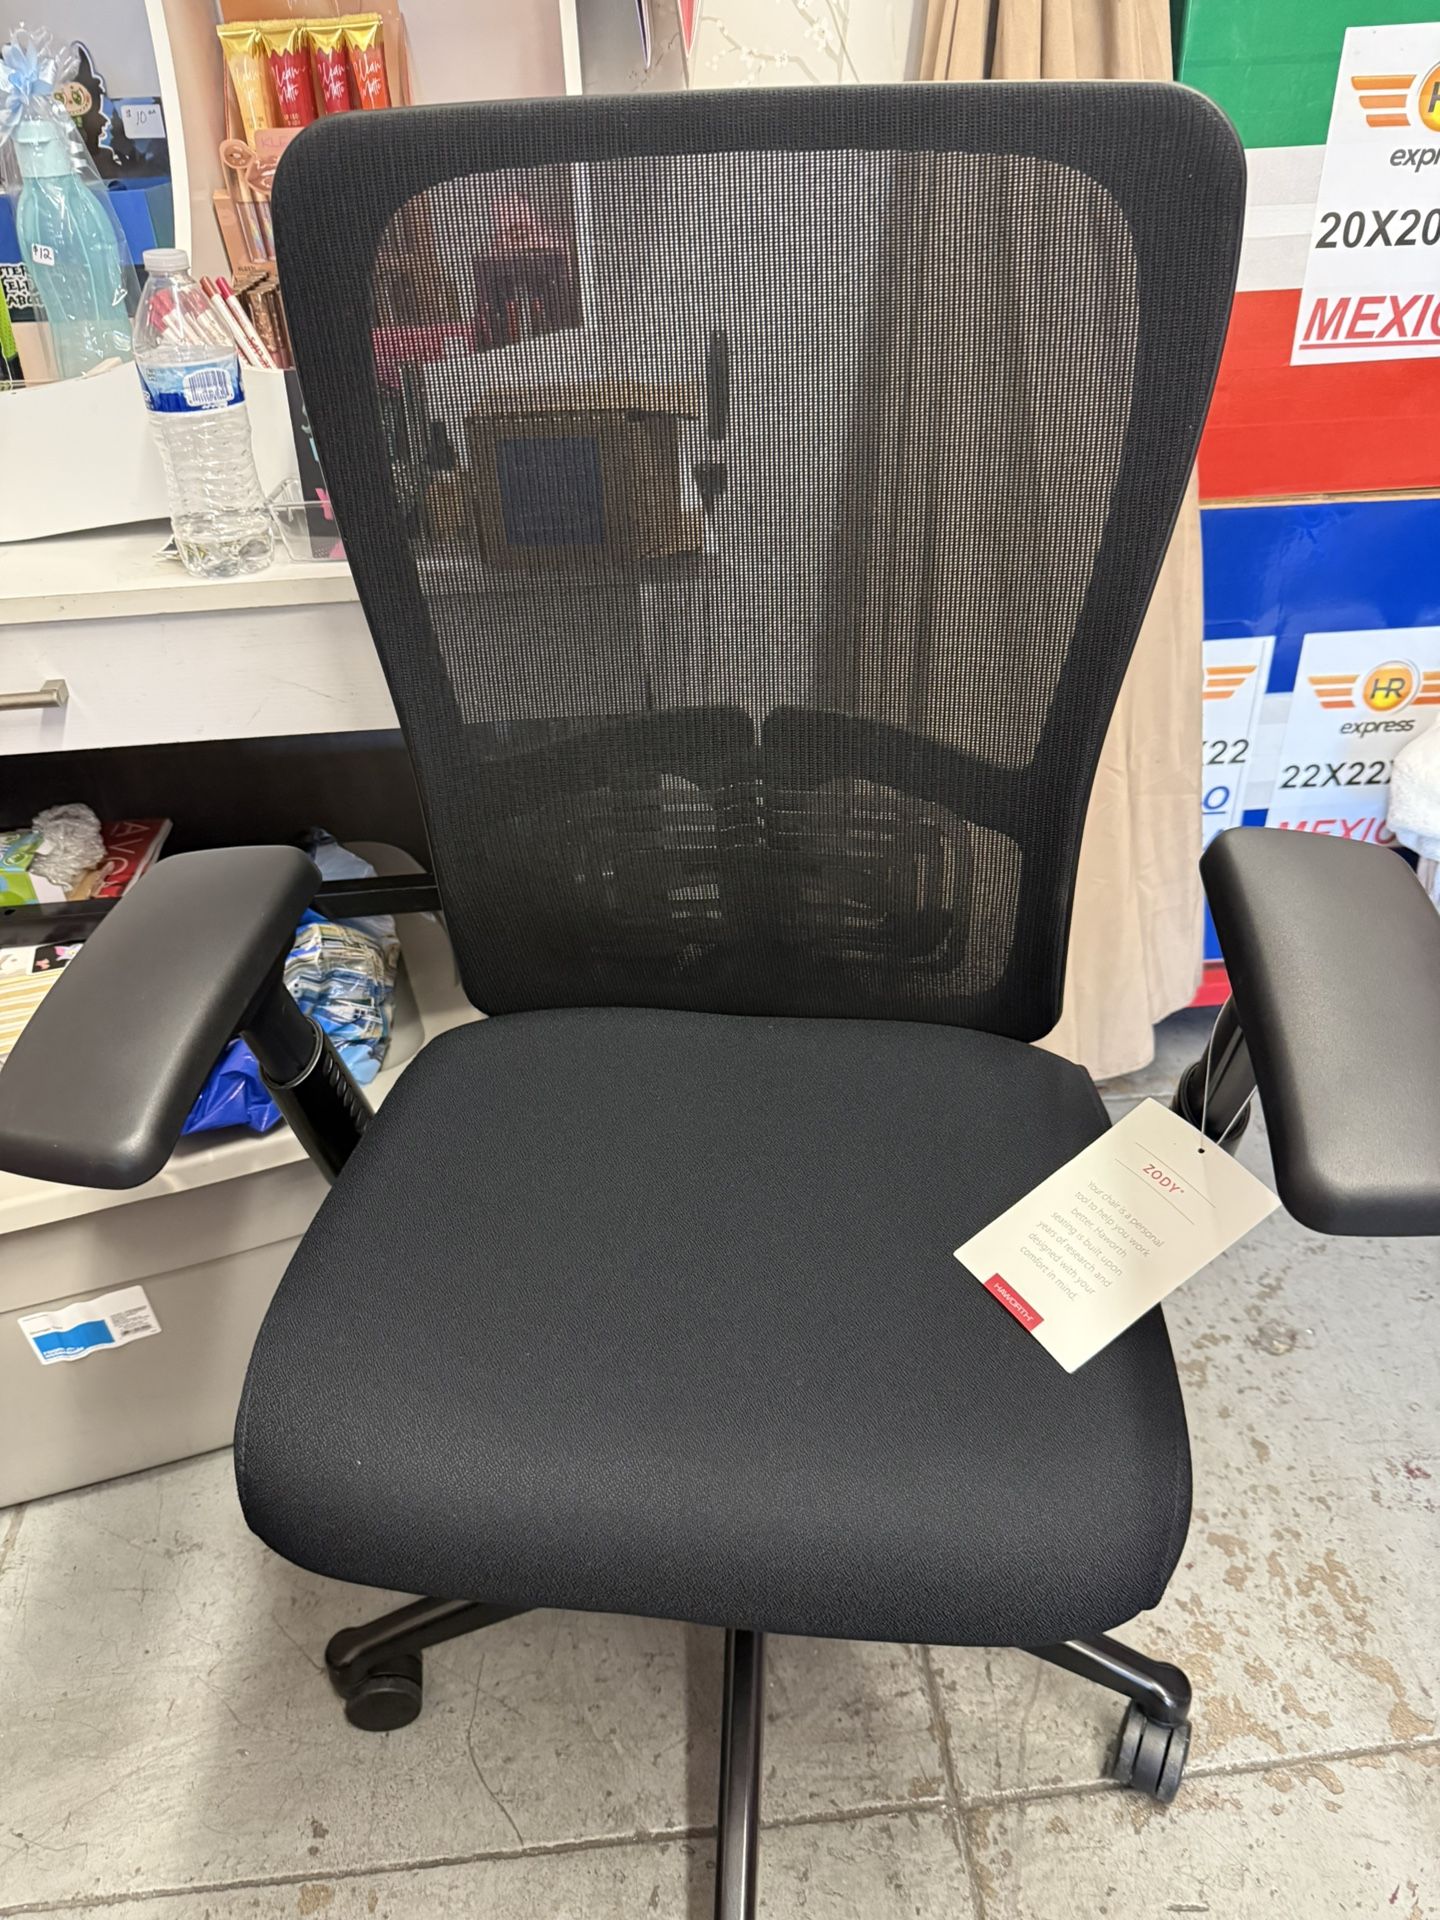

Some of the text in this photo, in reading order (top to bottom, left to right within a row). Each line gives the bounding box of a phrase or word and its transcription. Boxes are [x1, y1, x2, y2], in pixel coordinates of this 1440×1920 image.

[1370, 677, 1406, 699] HR
[1340, 719, 1415, 738] express
[1203, 738, 1249, 765] 22
[1096, 1207, 1114, 1226] help
[1112, 1224, 1129, 1239] you
[1128, 1237, 1151, 1257] work
[1101, 1192, 1121, 1209] chair
[1129, 1217, 1164, 1248] personal
[1019, 1245, 1049, 1273] comfort
[1036, 1220, 1057, 1238] years
[1063, 1242, 1096, 1272] research
[1094, 1271, 1112, 1288] and
[1050, 1210, 1077, 1236] seating
[1083, 1238, 1102, 1257] built
[1100, 1255, 1123, 1276] upon
[1094, 1226, 1128, 1258] Haworth
[1028, 1231, 1095, 1295] designed with your
[994, 1283, 1033, 1322] HAWORTH
